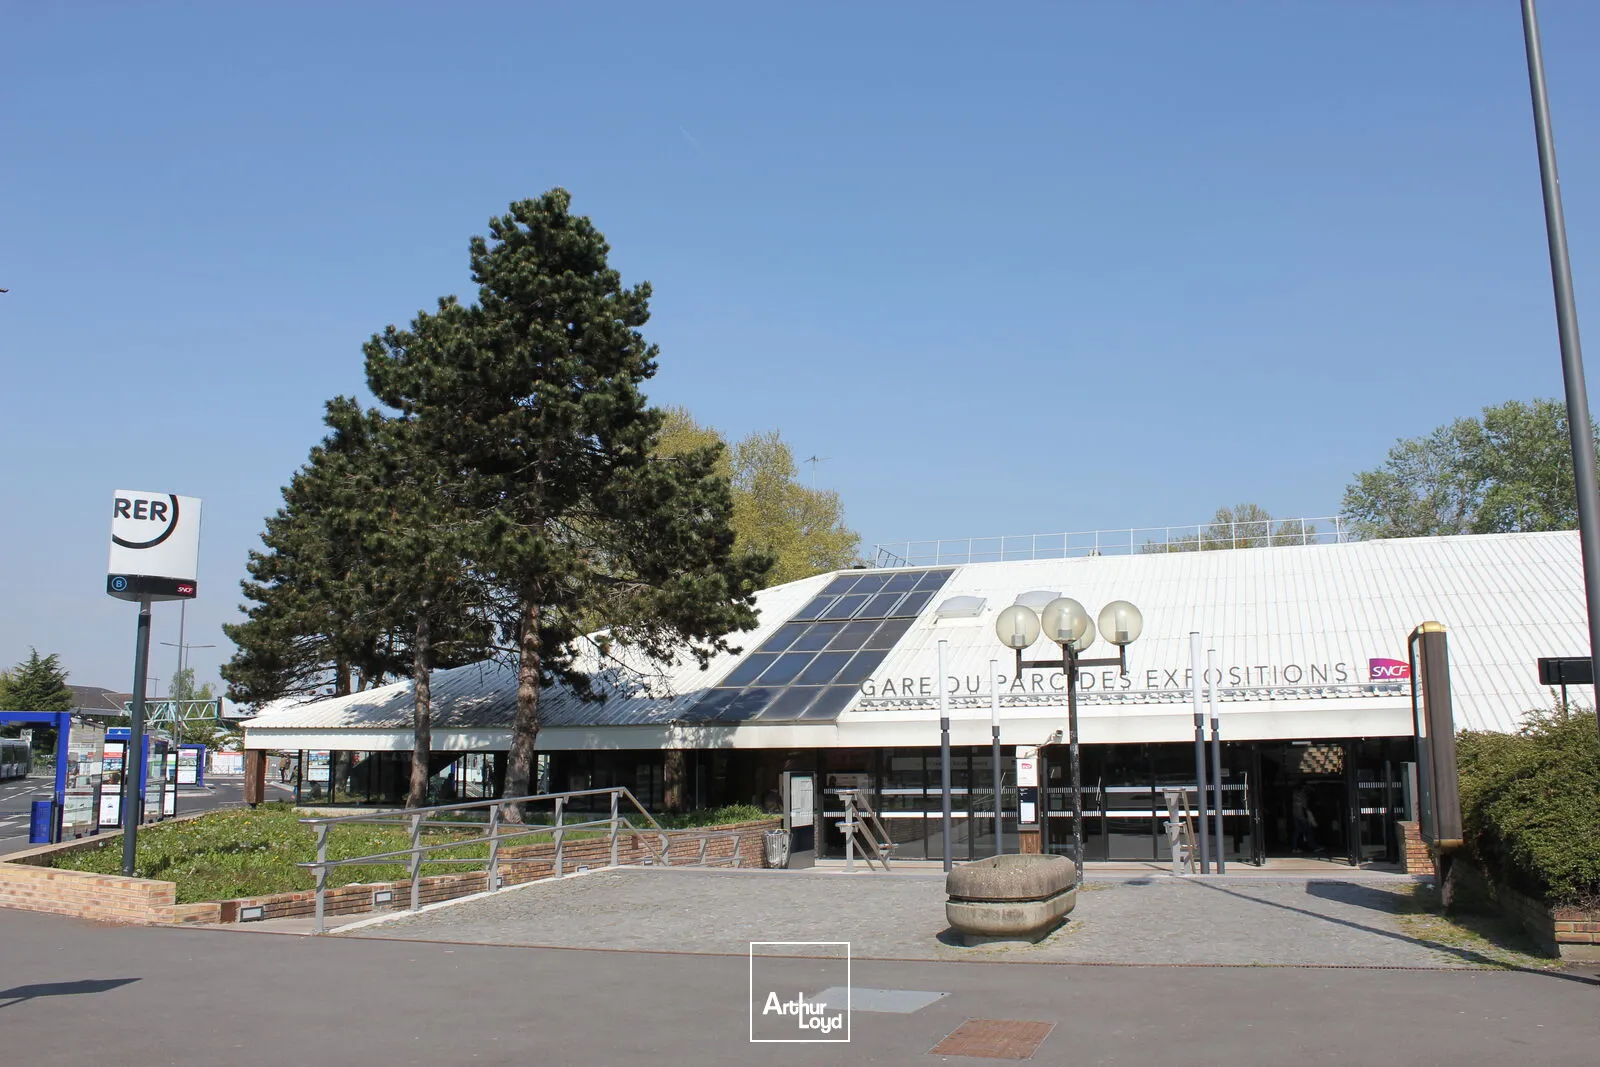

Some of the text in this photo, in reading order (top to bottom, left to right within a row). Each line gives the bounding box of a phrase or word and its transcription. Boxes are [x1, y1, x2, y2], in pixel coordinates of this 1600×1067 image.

[113, 498, 168, 522] RER
[1371, 665, 1409, 677] SNCF
[861, 677, 931, 697] GARE
[1080, 670, 1132, 690] DES
